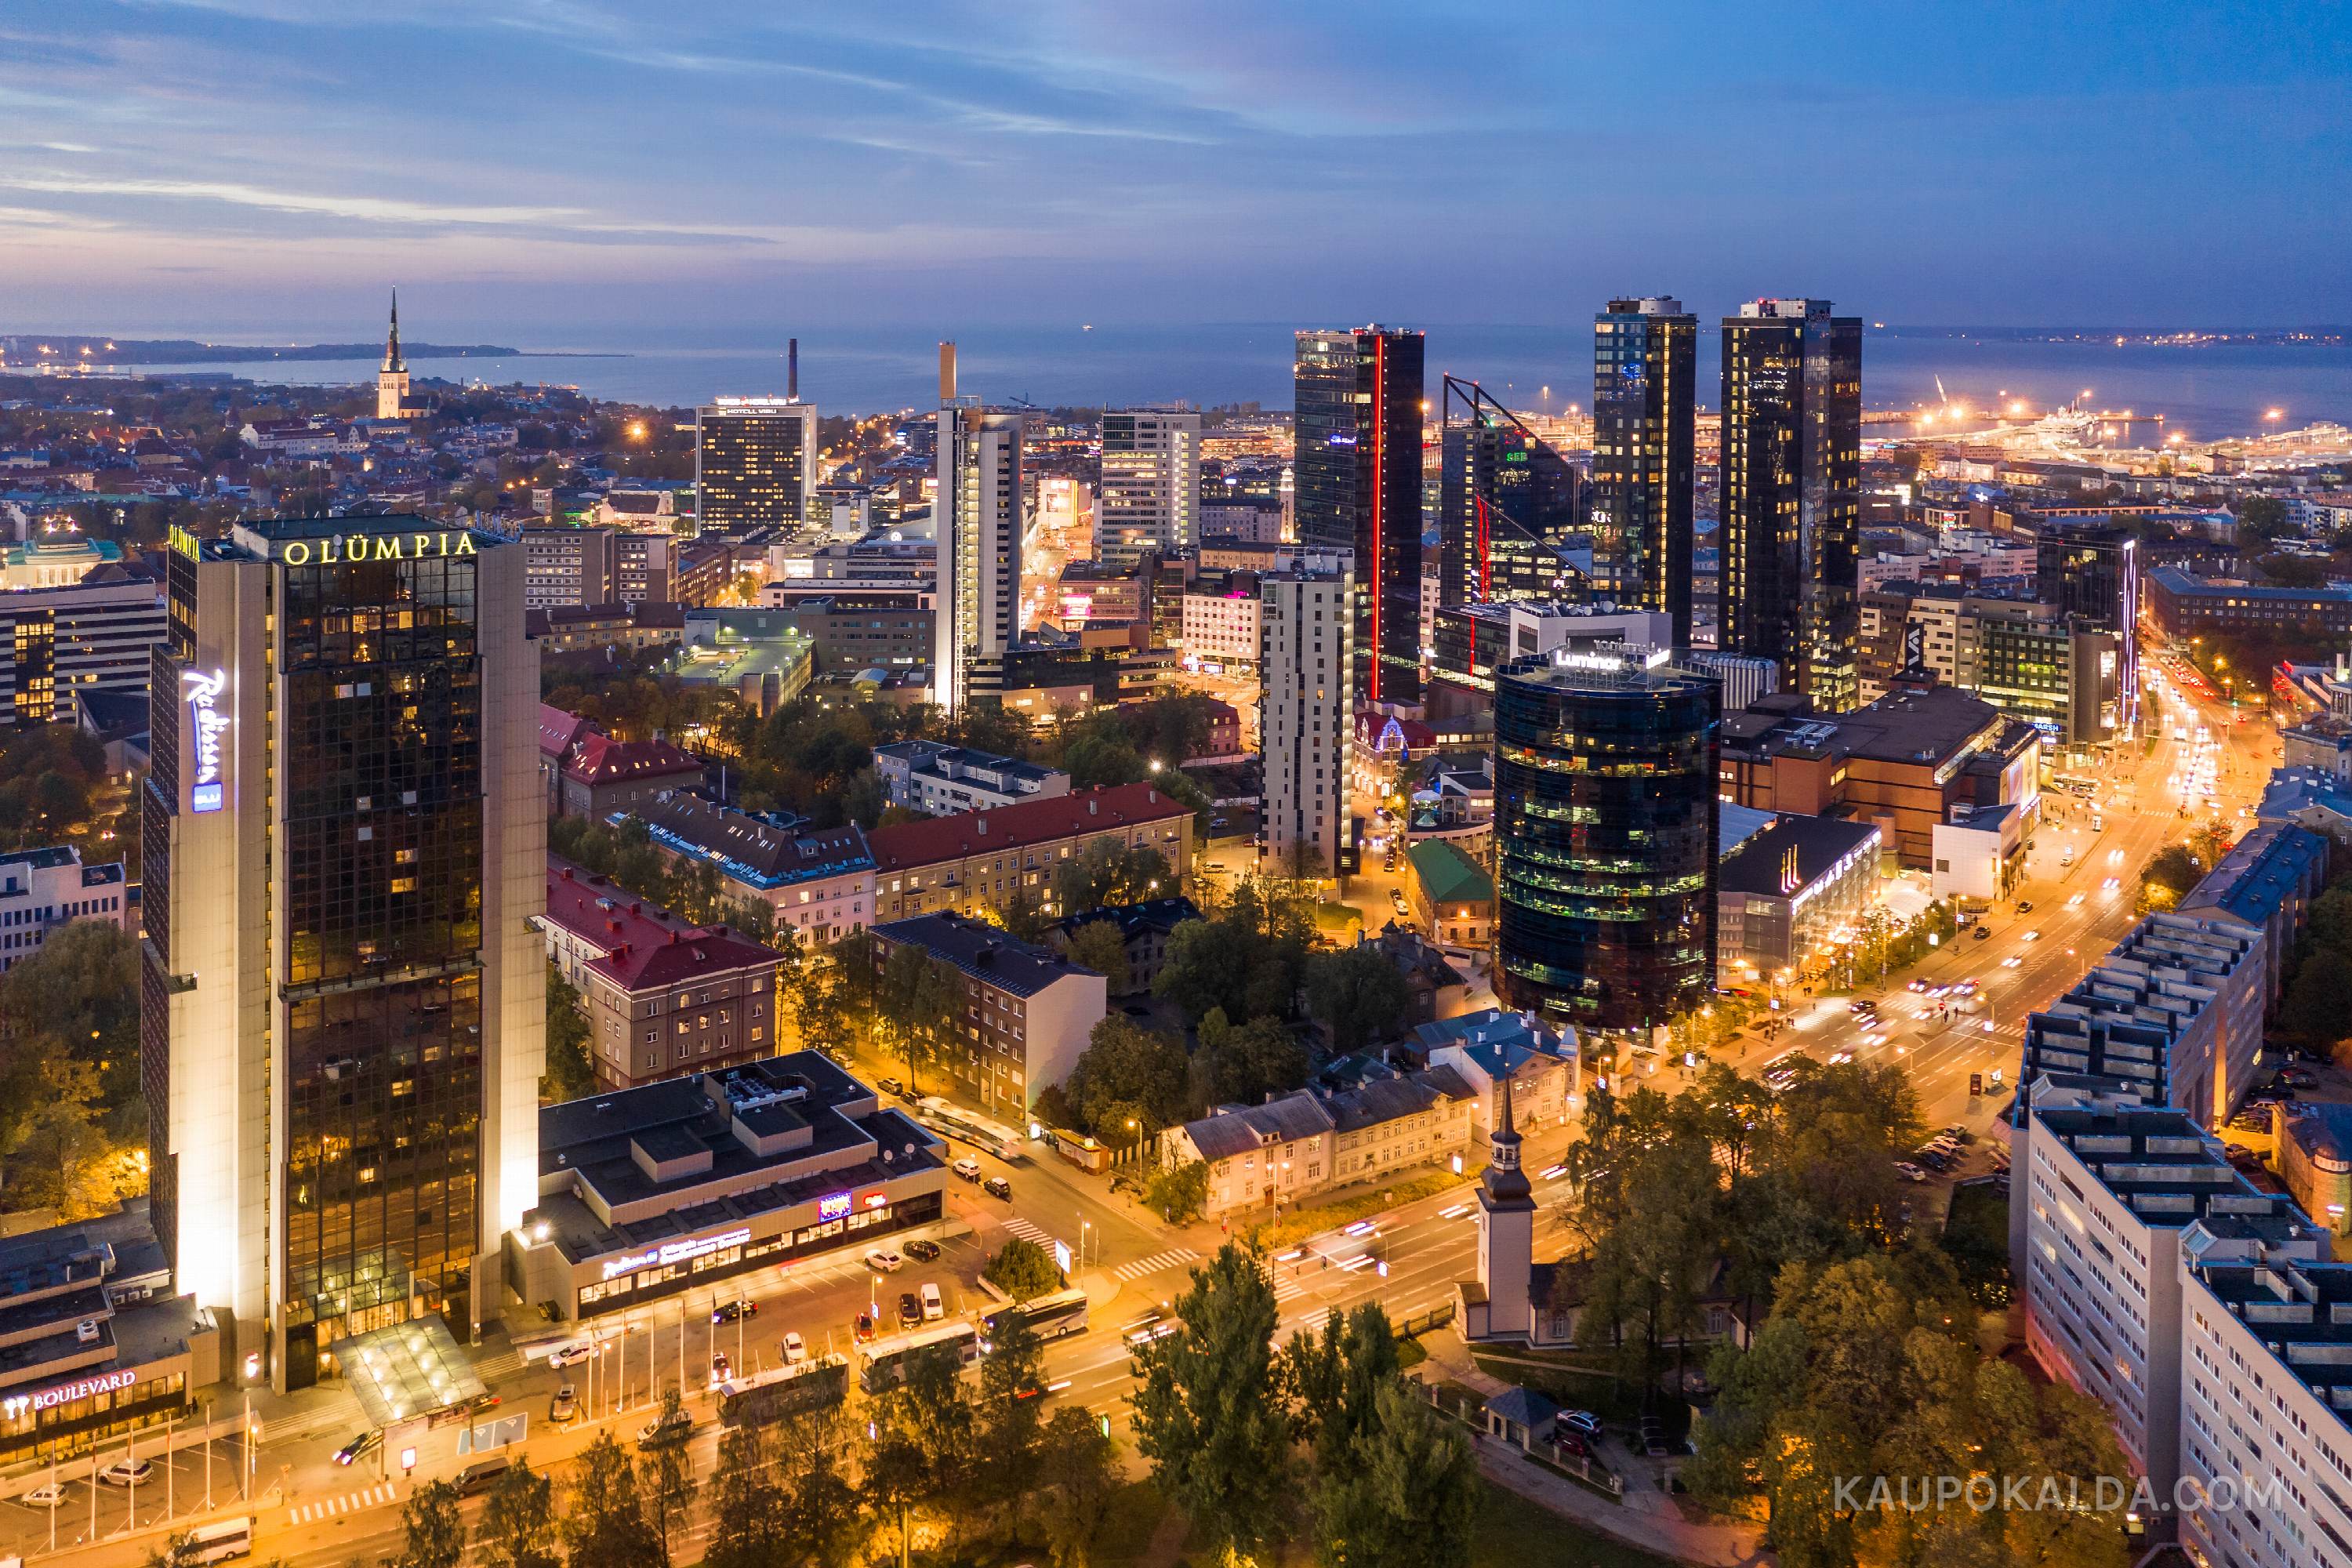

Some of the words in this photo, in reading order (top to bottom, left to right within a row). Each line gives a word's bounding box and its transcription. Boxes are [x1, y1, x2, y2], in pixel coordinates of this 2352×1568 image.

[284, 532, 477, 565] OLÜMPIA
[1556, 650, 1622, 670] Luminor
[182, 669, 230, 783] Radisson
[34, 1371, 136, 1410] BOULEVARD
